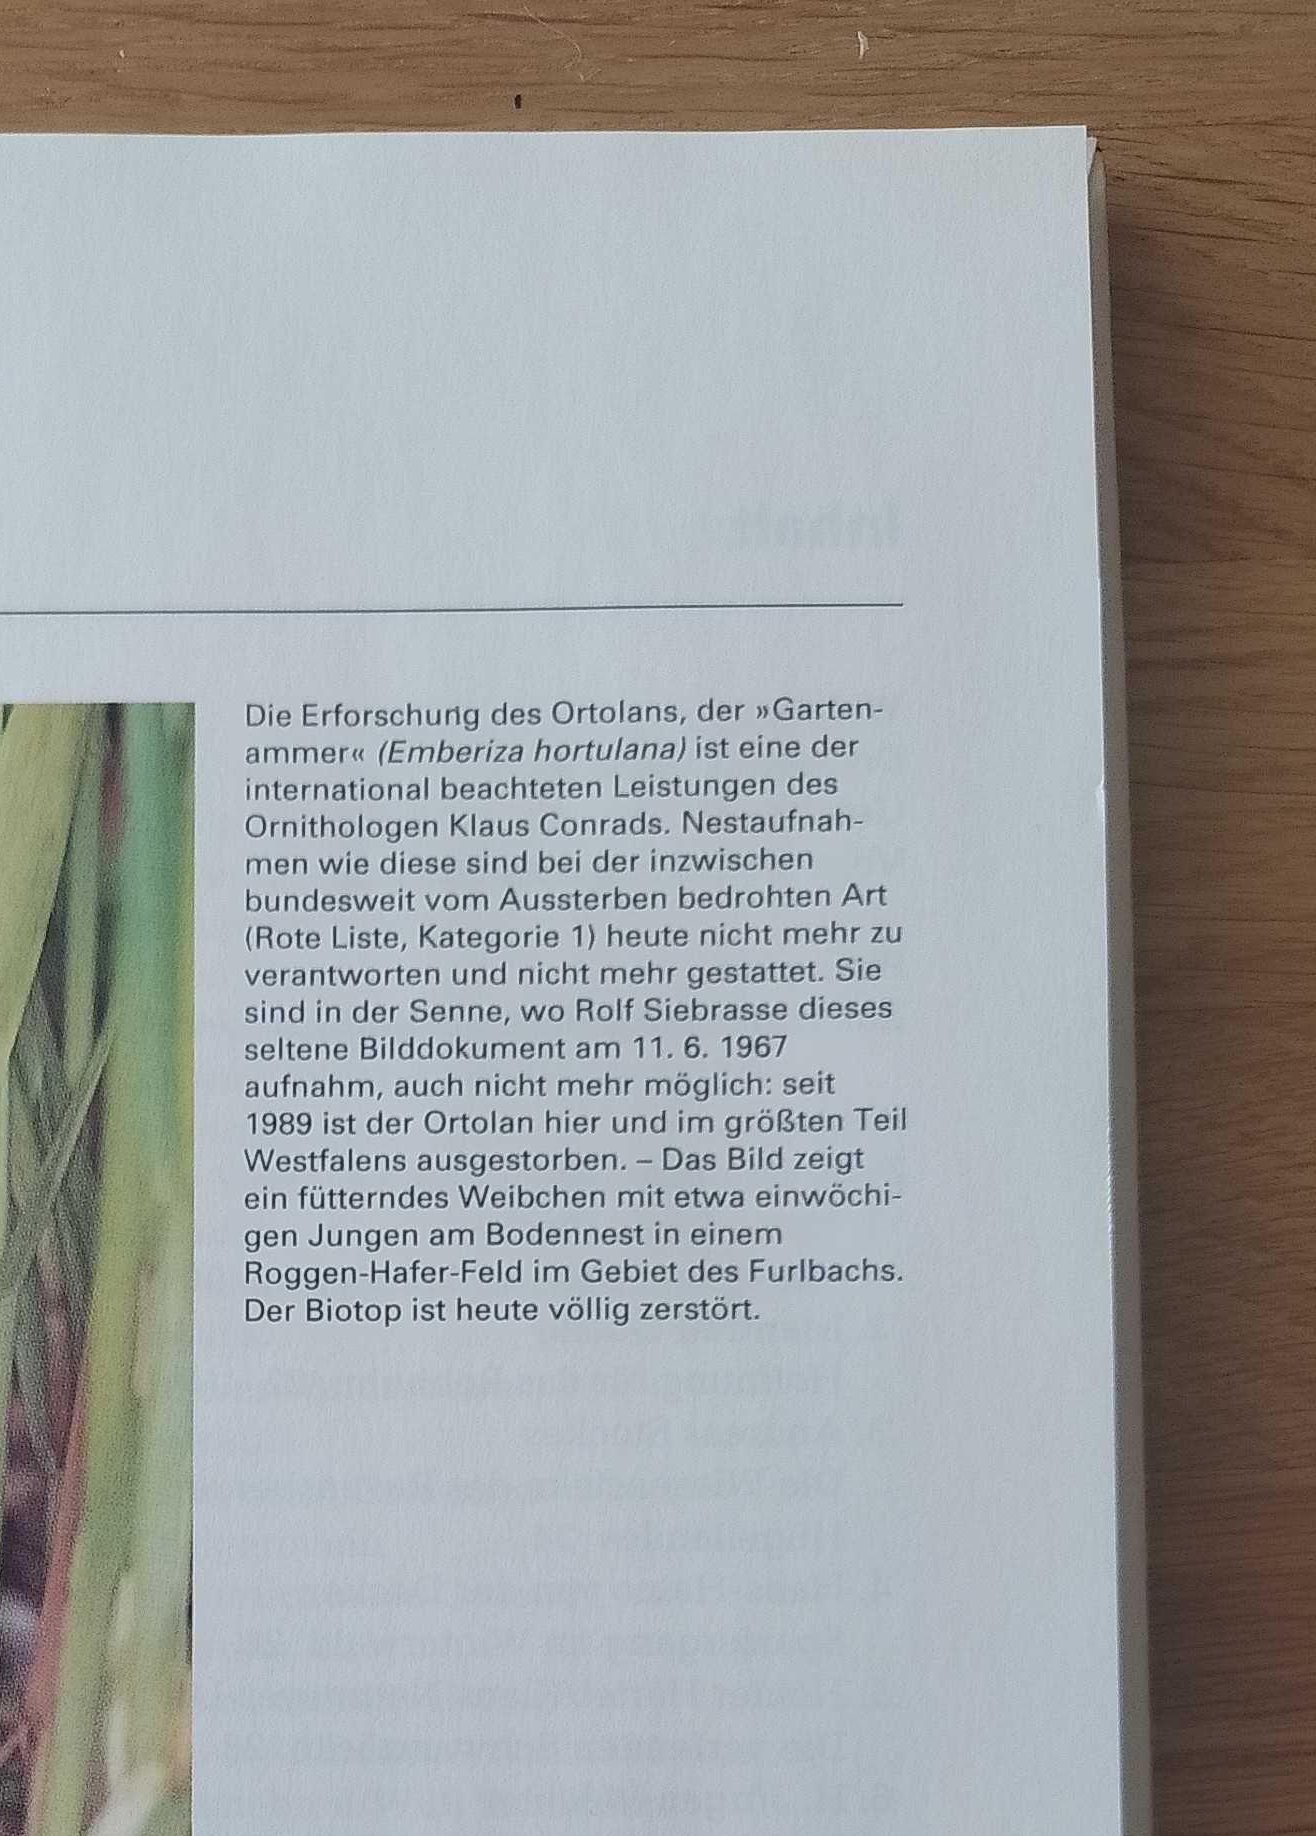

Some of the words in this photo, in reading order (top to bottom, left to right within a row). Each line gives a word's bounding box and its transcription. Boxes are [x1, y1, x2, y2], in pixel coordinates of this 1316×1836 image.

[246, 702, 292, 728] Die
[302, 702, 480, 732] Erforschung
[490, 701, 542, 727] des
[551, 698, 687, 726] Ortolans,
[696, 697, 746, 723] der
[756, 695, 884, 722] »Garten-
[245, 745, 365, 765] ammer«
[378, 738, 524, 767] (Emberiza
[533, 735, 687, 763] hortulana)
[696, 735, 730, 760] ist
[738, 734, 801, 760] eine
[810, 733, 860, 759] der
[245, 776, 430, 802] international
[440, 775, 602, 801] beachteten
[614, 773, 776, 803] Leistungen
[786, 770, 839, 796] des
[245, 813, 439, 844] Ornithologen
[450, 812, 530, 838] Klaus
[539, 810, 671, 837] Conrads.
[682, 807, 864, 835] Nestaufnah-
[245, 857, 308, 876] men
[318, 850, 370, 876] wie
[379, 850, 457, 876] diese
[466, 849, 528, 875] sind
[538, 849, 581, 875] bei
[592, 848, 641, 874] der
[650, 846, 814, 873] inzwischen
[245, 887, 416, 913] bundesweit
[424, 893, 489, 912] vom
[498, 885, 667, 912] Aussterben
[678, 883, 831, 910] bedrohten
[840, 882, 888, 907] Art
[245, 924, 321, 952] (Rote
[332, 924, 407, 953] Liste,
[419, 923, 560, 955] Kategorie
[571, 923, 596, 951] 1)
[607, 923, 689, 948] heute
[699, 921, 773, 947] nicht
[782, 919, 861, 946] mehr
[870, 925, 903, 944] zu
[244, 964, 441, 987] verantworten
[451, 960, 507, 986] und
[518, 960, 590, 986] nicht
[600, 959, 678, 985] mehr
[686, 960, 825, 991] gestattet.
[835, 956, 882, 982] Sie
[244, 999, 305, 1024] sind
[316, 998, 342, 1024] in
[352, 998, 400, 1024] der
[409, 998, 511, 1027] Senne,
[520, 1004, 565, 1023] wo
[575, 997, 635, 1023] Rolf
[643, 996, 788, 1023] Siebrasse
[798, 995, 893, 1021] dieses
[244, 1036, 349, 1062] seltene
[360, 1035, 566, 1061] Bilddokument
[575, 1040, 621, 1060] am
[633, 1035, 673, 1059] 11.
[683, 1035, 709, 1060] 6.
[721, 1034, 788, 1059] 1967
[244, 1072, 384, 1101] aufnahm,
[393, 1072, 464, 1098] auch
[474, 1072, 547, 1097] nicht
[557, 1071, 635, 1097] mehr
[644, 1071, 772, 1103] möglich:
[782, 1069, 836, 1096] seit
[246, 1111, 313, 1136] 1989
[323, 1110, 357, 1136] ist
[365, 1109, 415, 1136] der
[423, 1109, 534, 1135] Ortolan
[545, 1109, 602, 1135] hier
[611, 1109, 667, 1135] und
[678, 1109, 715, 1134] im
[724, 1107, 844, 1140] größten
[852, 1106, 907, 1132] Teil
[243, 1147, 407, 1173] Westfalens
[416, 1146, 627, 1178] ausgestorben.
[662, 1146, 717, 1172] Das
[727, 1145, 784, 1171] Bild
[793, 1145, 865, 1176] zeigt
[244, 1185, 287, 1210] ein
[297, 1184, 449, 1211] fütterndes
[457, 1184, 606, 1209] Weibchen
[617, 1183, 666, 1209] mit
[674, 1186, 745, 1209] etwa
[755, 1181, 902, 1209] einwöchi-
[243, 1228, 298, 1254] gen
[307, 1222, 418, 1253] Jungen
[429, 1227, 475, 1247] am
[486, 1220, 645, 1247] Bodennest
[654, 1220, 680, 1246] in
[690, 1221, 783, 1246] einem
[245, 1258, 523, 1291] Roggen-Hafer-Feld
[533, 1258, 570, 1284] im
[580, 1257, 679, 1284] Gebiet
[687, 1258, 740, 1284] des
[749, 1257, 903, 1284] Furlbachs.
[245, 1297, 296, 1323] Der
[306, 1297, 402, 1328] Biotop
[412, 1296, 447, 1322] ist
[456, 1296, 539, 1322] heute
[548, 1296, 630, 1327] völlig
[639, 1295, 760, 1321] zerstört.
